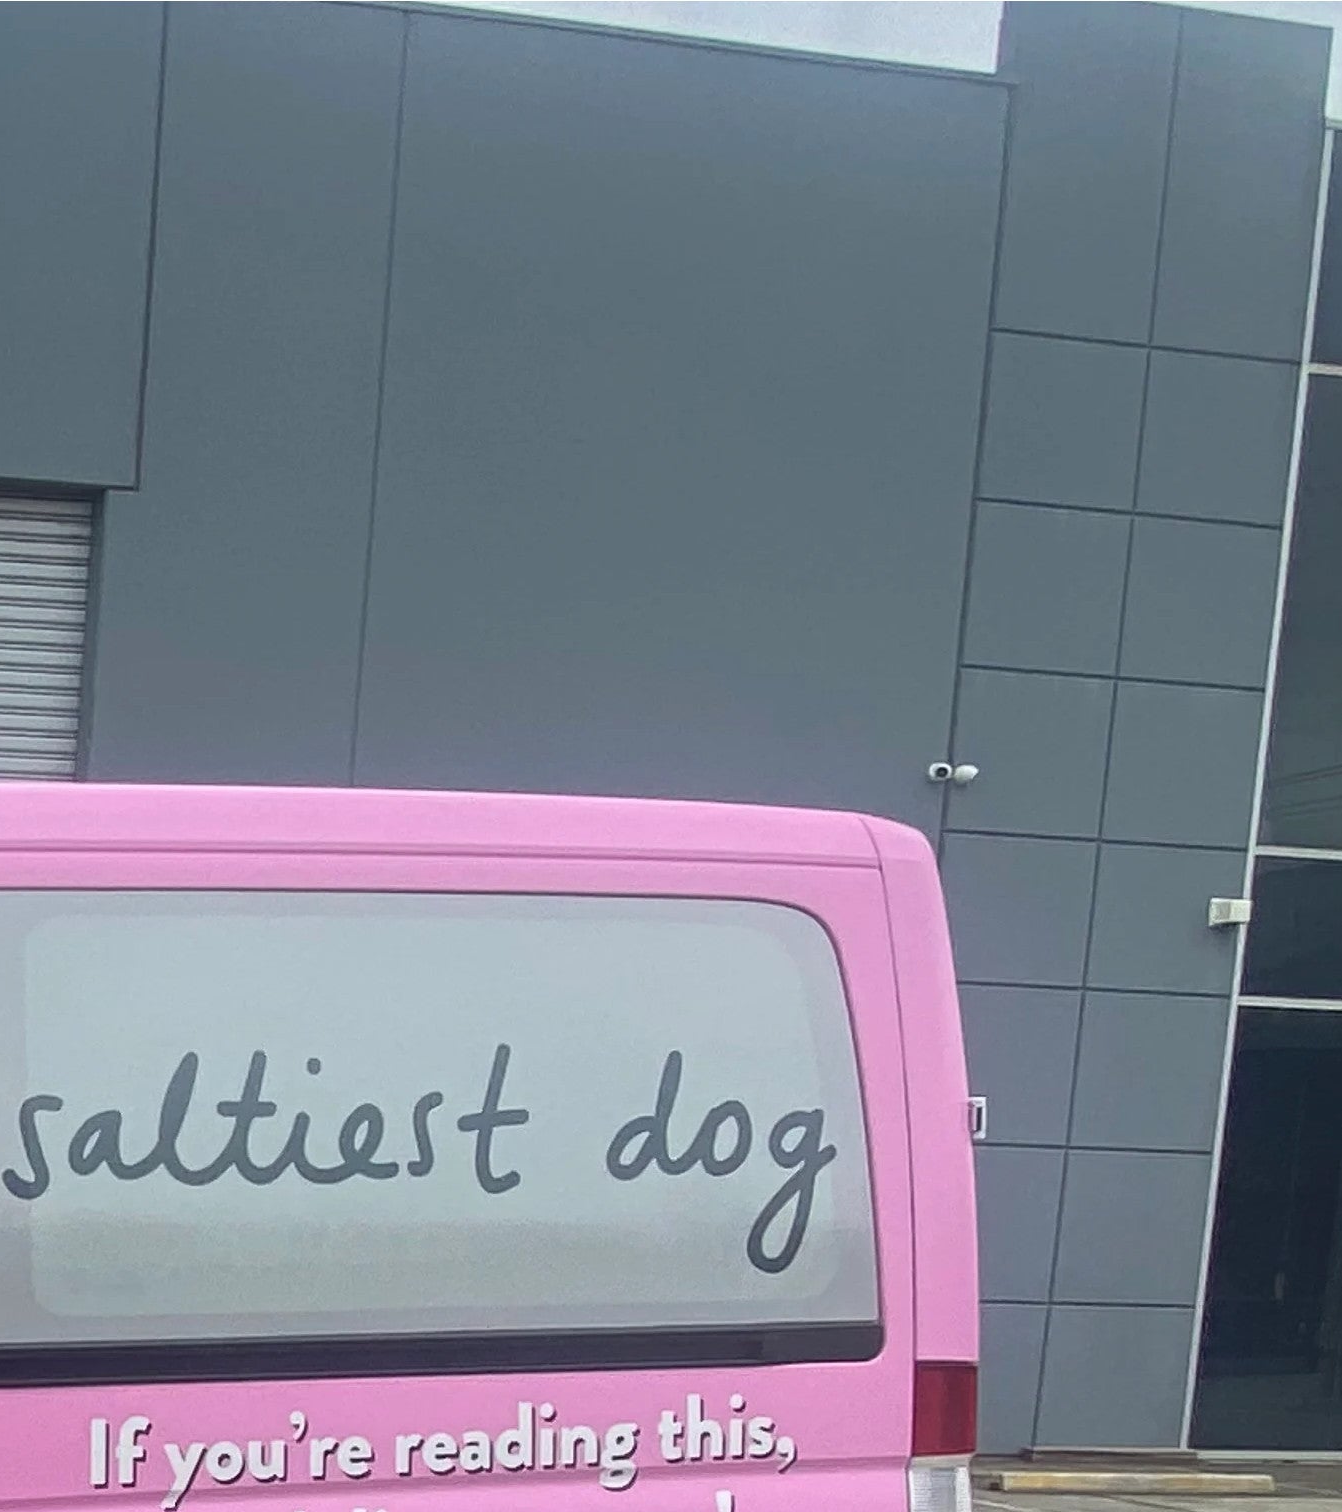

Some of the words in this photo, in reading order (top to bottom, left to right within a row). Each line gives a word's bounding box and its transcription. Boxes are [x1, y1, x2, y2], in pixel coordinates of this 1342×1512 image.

[3, 1043, 530, 1199] saltiest
[605, 1049, 837, 1275] dog
[88, 1416, 148, 1488] If
[161, 1411, 374, 1511] you're
[395, 1401, 639, 1490] reading
[658, 1394, 796, 1469] this,
